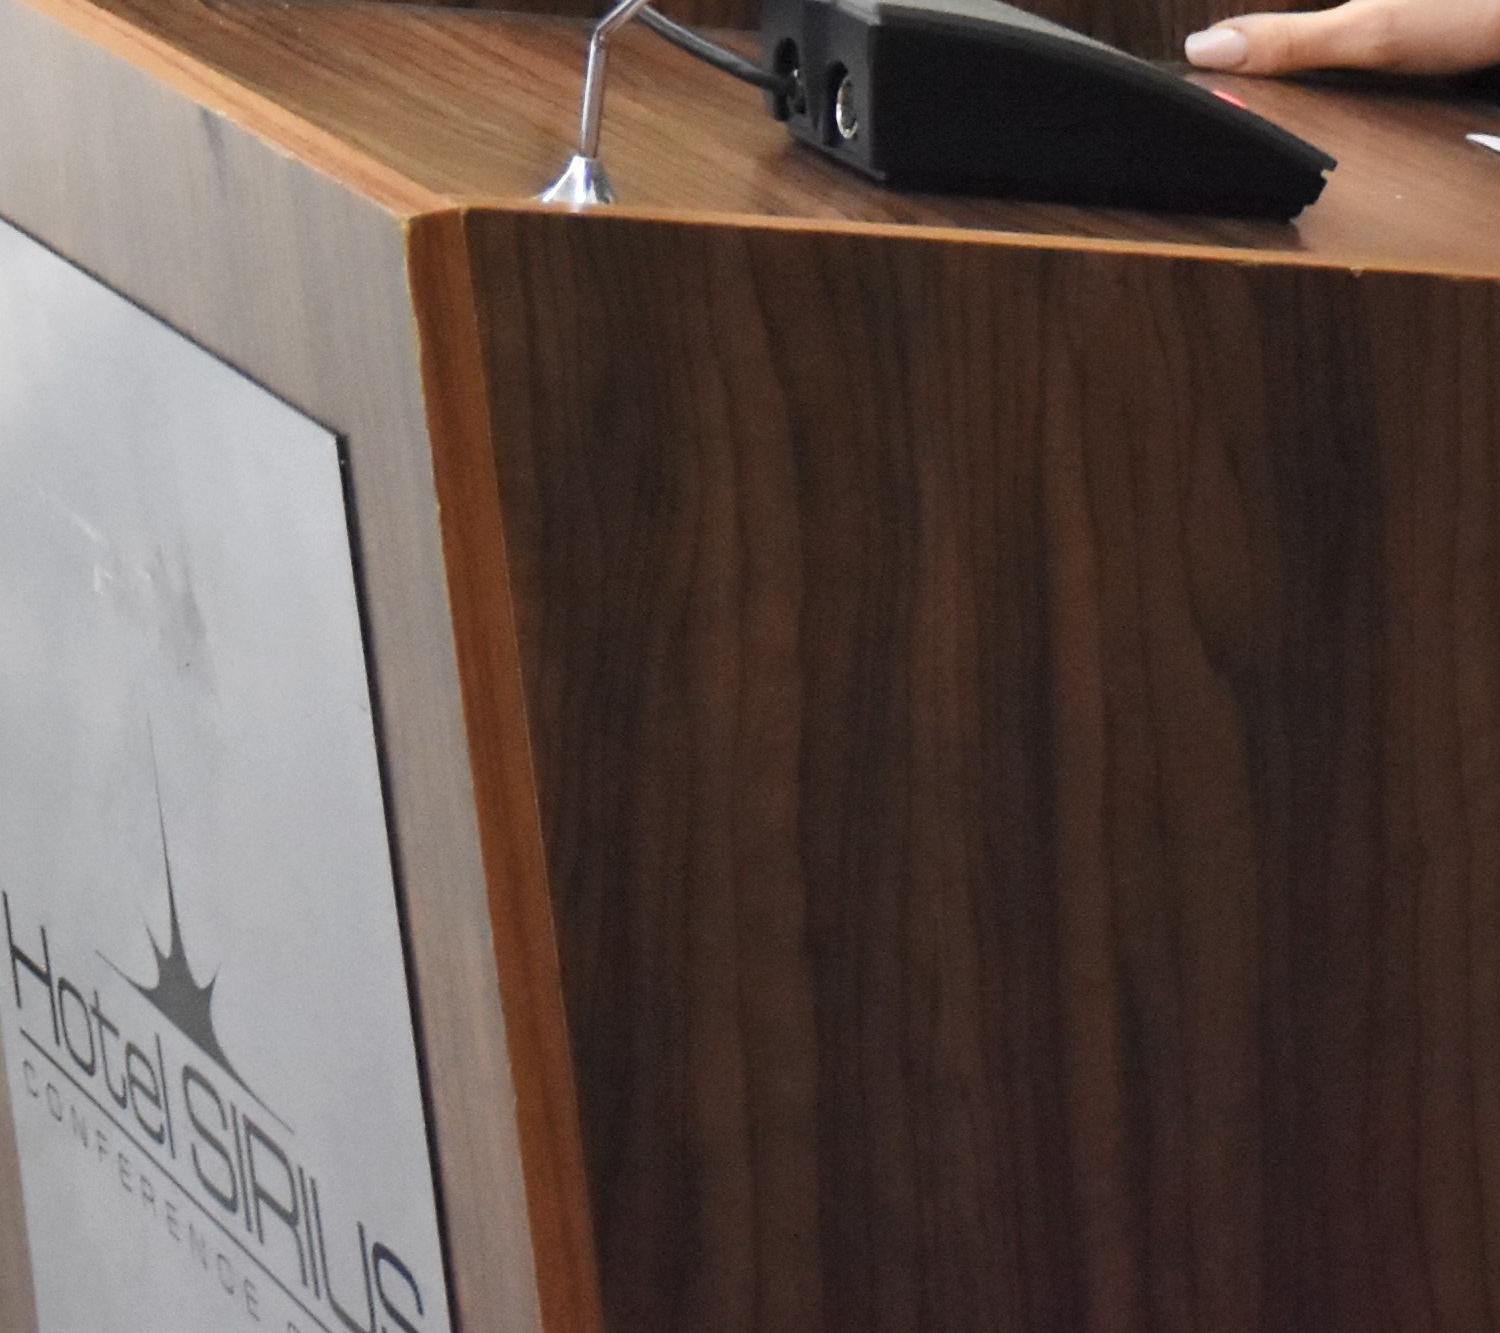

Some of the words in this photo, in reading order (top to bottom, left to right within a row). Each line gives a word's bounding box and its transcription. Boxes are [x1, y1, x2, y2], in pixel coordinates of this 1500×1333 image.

[2, 890, 176, 1160] Hotel
[181, 1063, 424, 1333] SIRIUS
[22, 1058, 261, 1323] CONFERENCE
